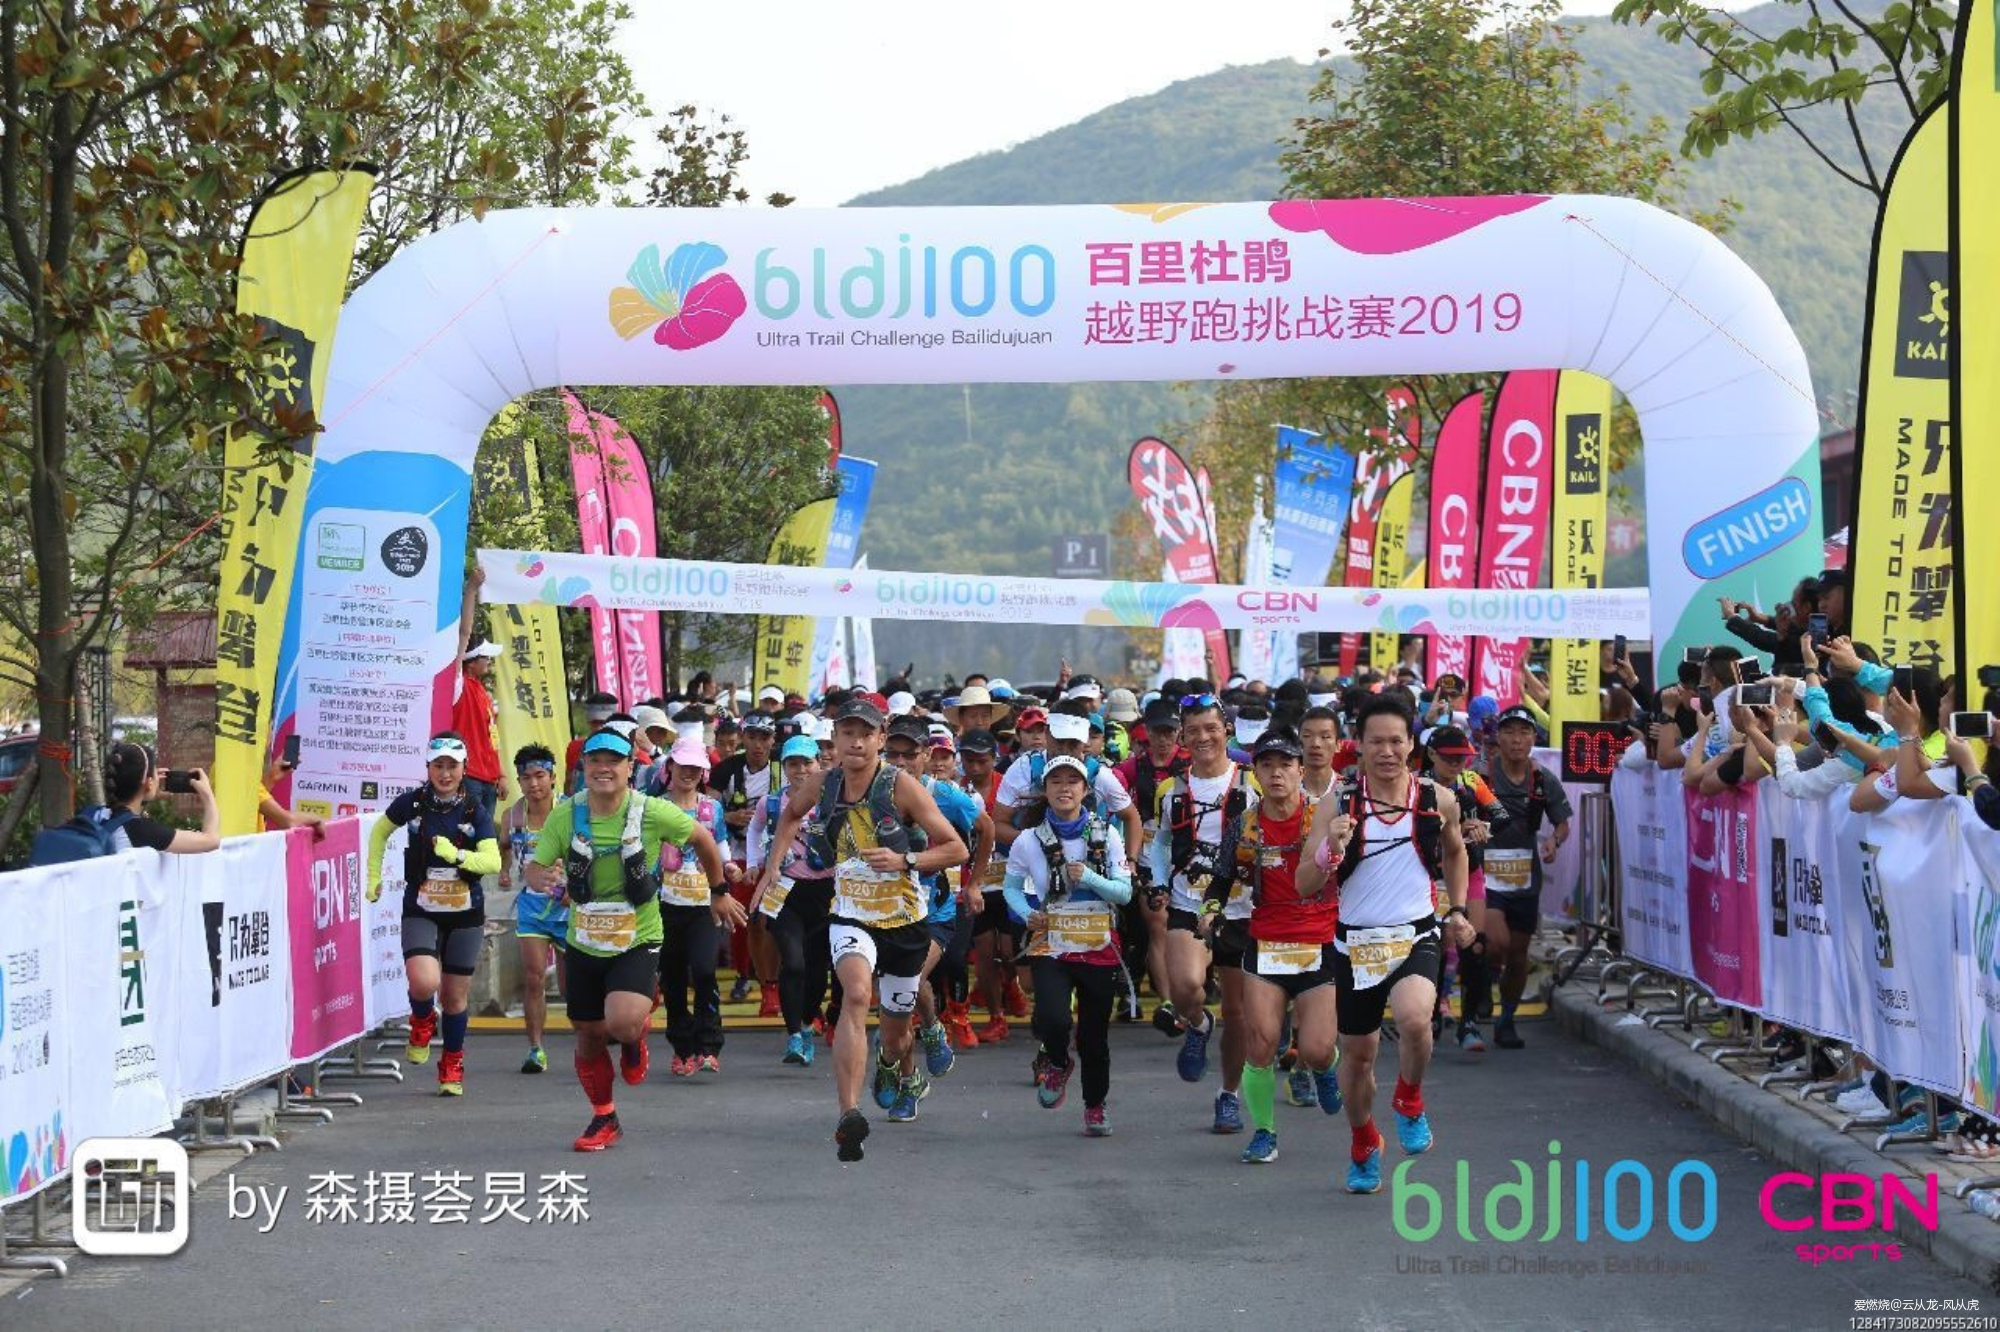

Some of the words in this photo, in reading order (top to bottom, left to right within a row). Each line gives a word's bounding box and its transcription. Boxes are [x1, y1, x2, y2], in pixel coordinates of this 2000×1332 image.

[1085, 238, 1291, 286] 百里杜鹃
[1084, 292, 1523, 345] 越野跑挑战赛2019
[757, 331, 800, 347] Ultra
[806, 331, 844, 347] Trail
[851, 329, 944, 348] Challenge
[952, 328, 1053, 347] Bailidujuan
[1906, 341, 1947, 361] KAI
[1697, 488, 1807, 566] FINISH
[1237, 591, 1318, 613] CBN
[1252, 616, 1300, 625] sports
[297, 780, 348, 795] GARMIN
[846, 881, 878, 897] 3207
